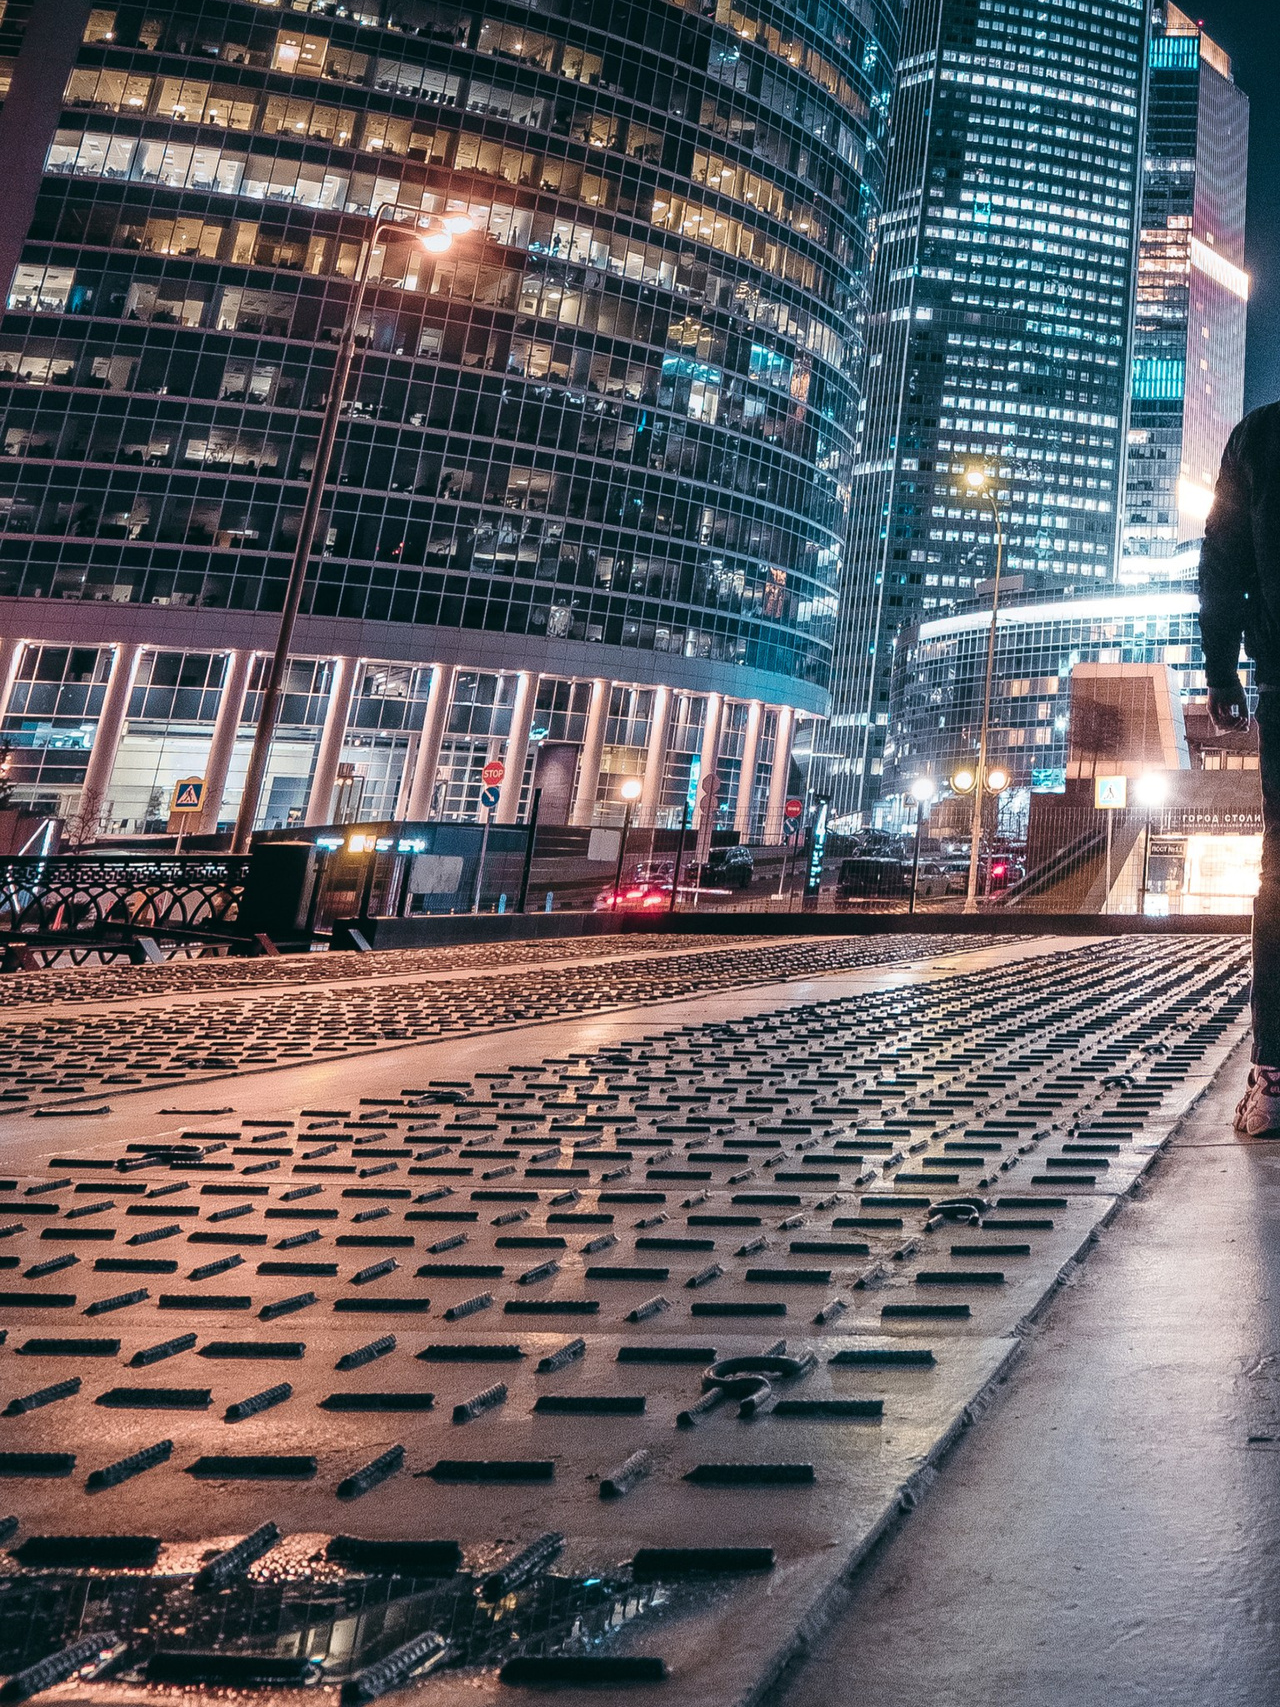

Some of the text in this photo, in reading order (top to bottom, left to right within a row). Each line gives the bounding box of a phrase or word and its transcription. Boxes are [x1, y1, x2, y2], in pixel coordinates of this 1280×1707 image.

[484, 769, 503, 778] STOP
[1182, 814, 1261, 824] ГОРОД СТОЛИ
